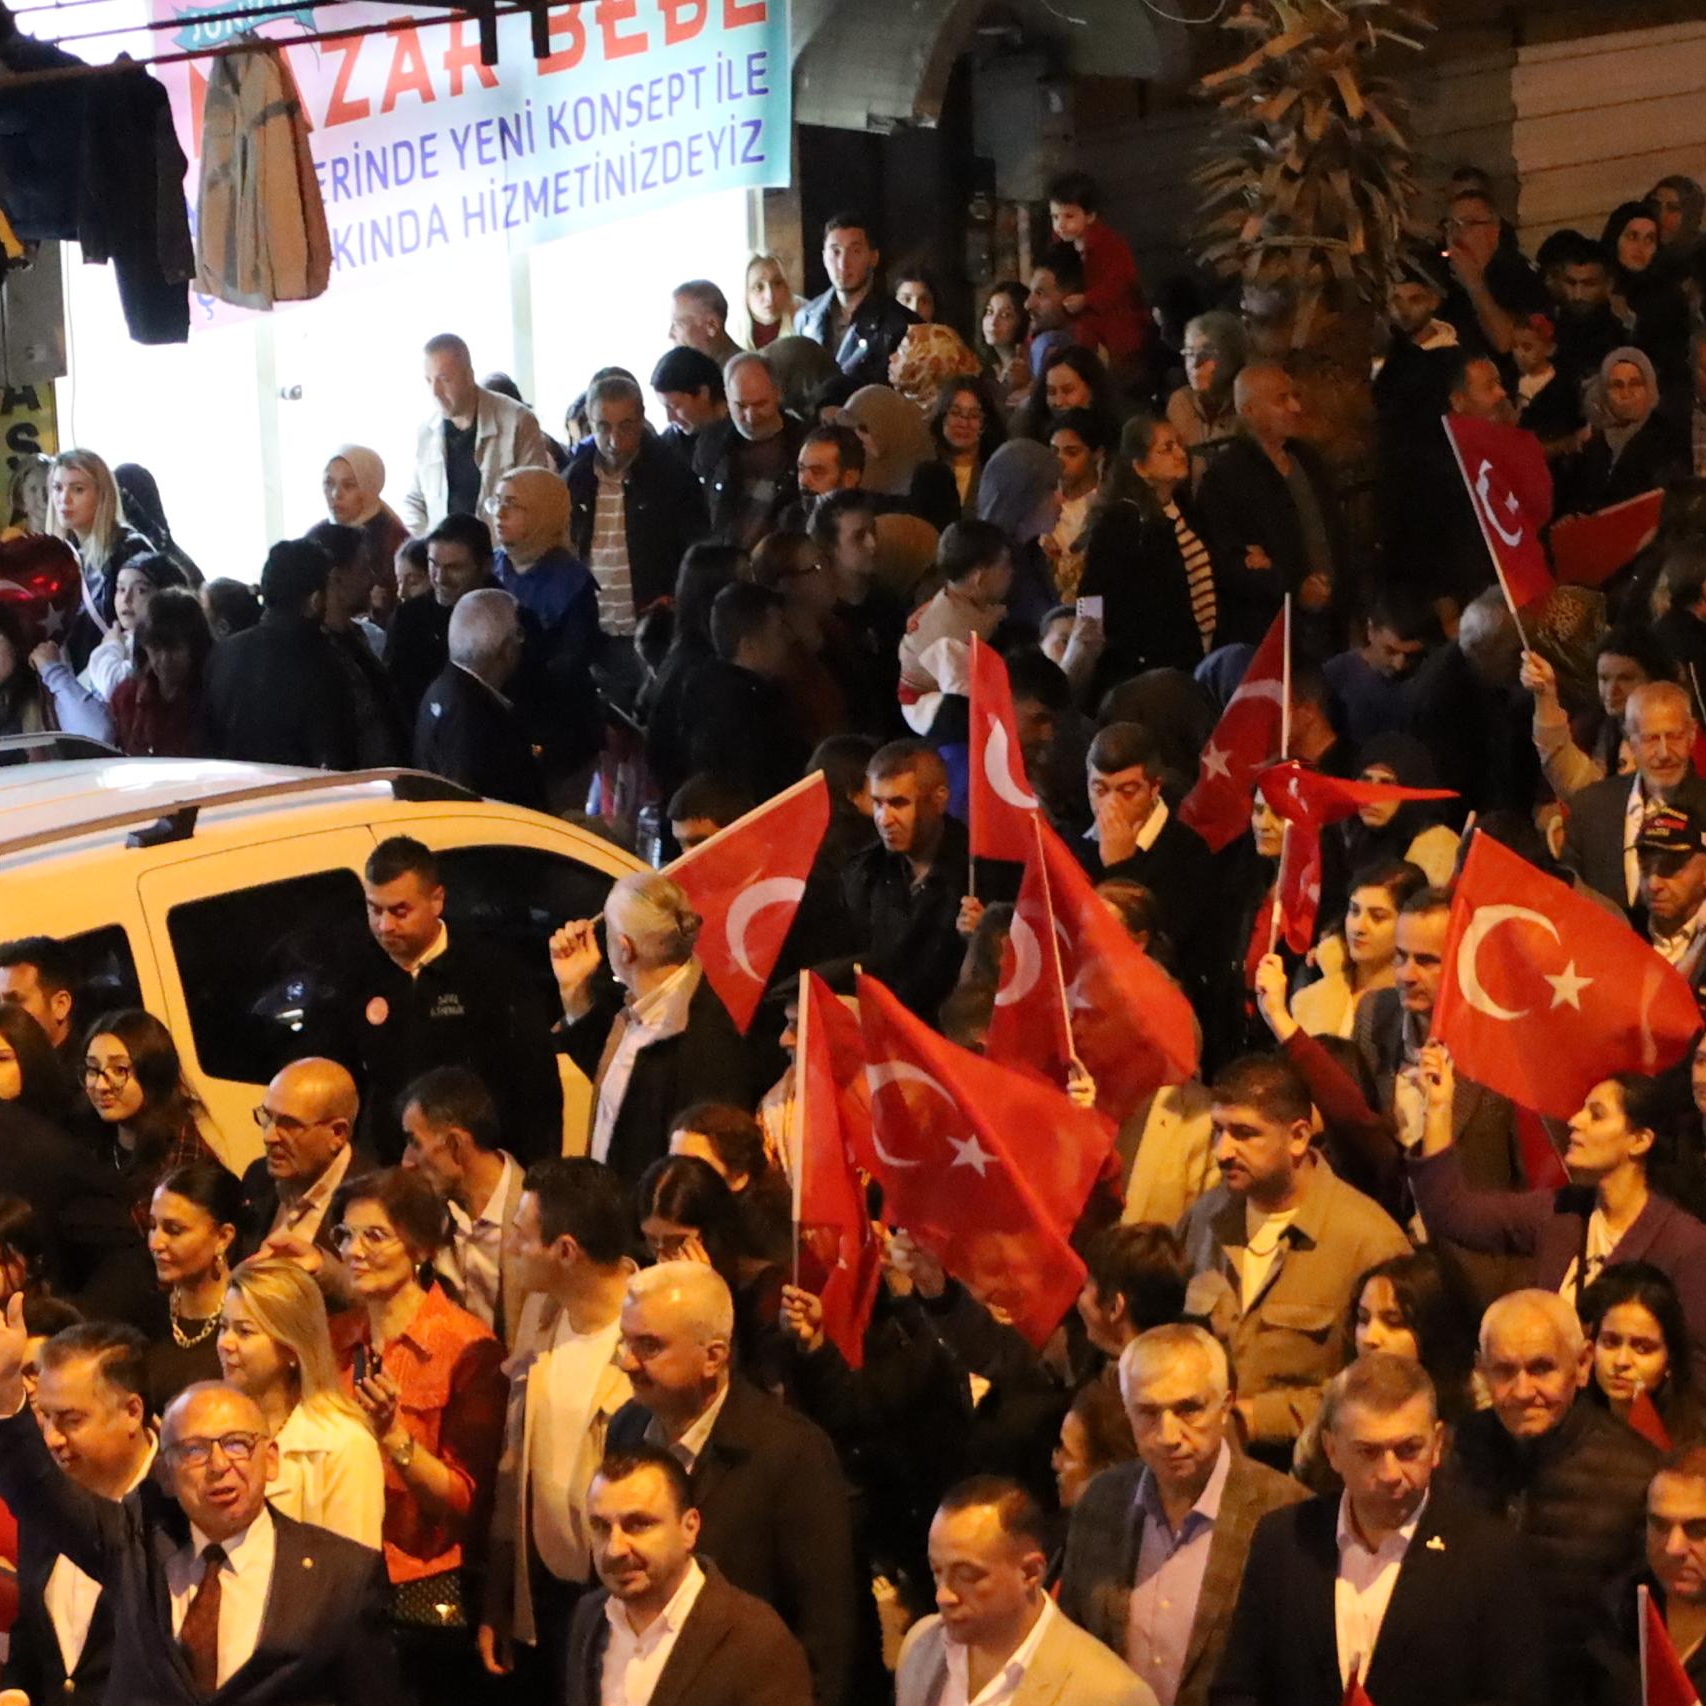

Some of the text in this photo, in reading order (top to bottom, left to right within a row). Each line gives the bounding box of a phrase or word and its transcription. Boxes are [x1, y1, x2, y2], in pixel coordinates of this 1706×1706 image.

[450, 99, 535, 171] YENİ
[547, 66, 707, 149] KONSEPT
[717, 51, 769, 104] İLE
[462, 113, 766, 239] HİZMETİNİZDEYİZ
